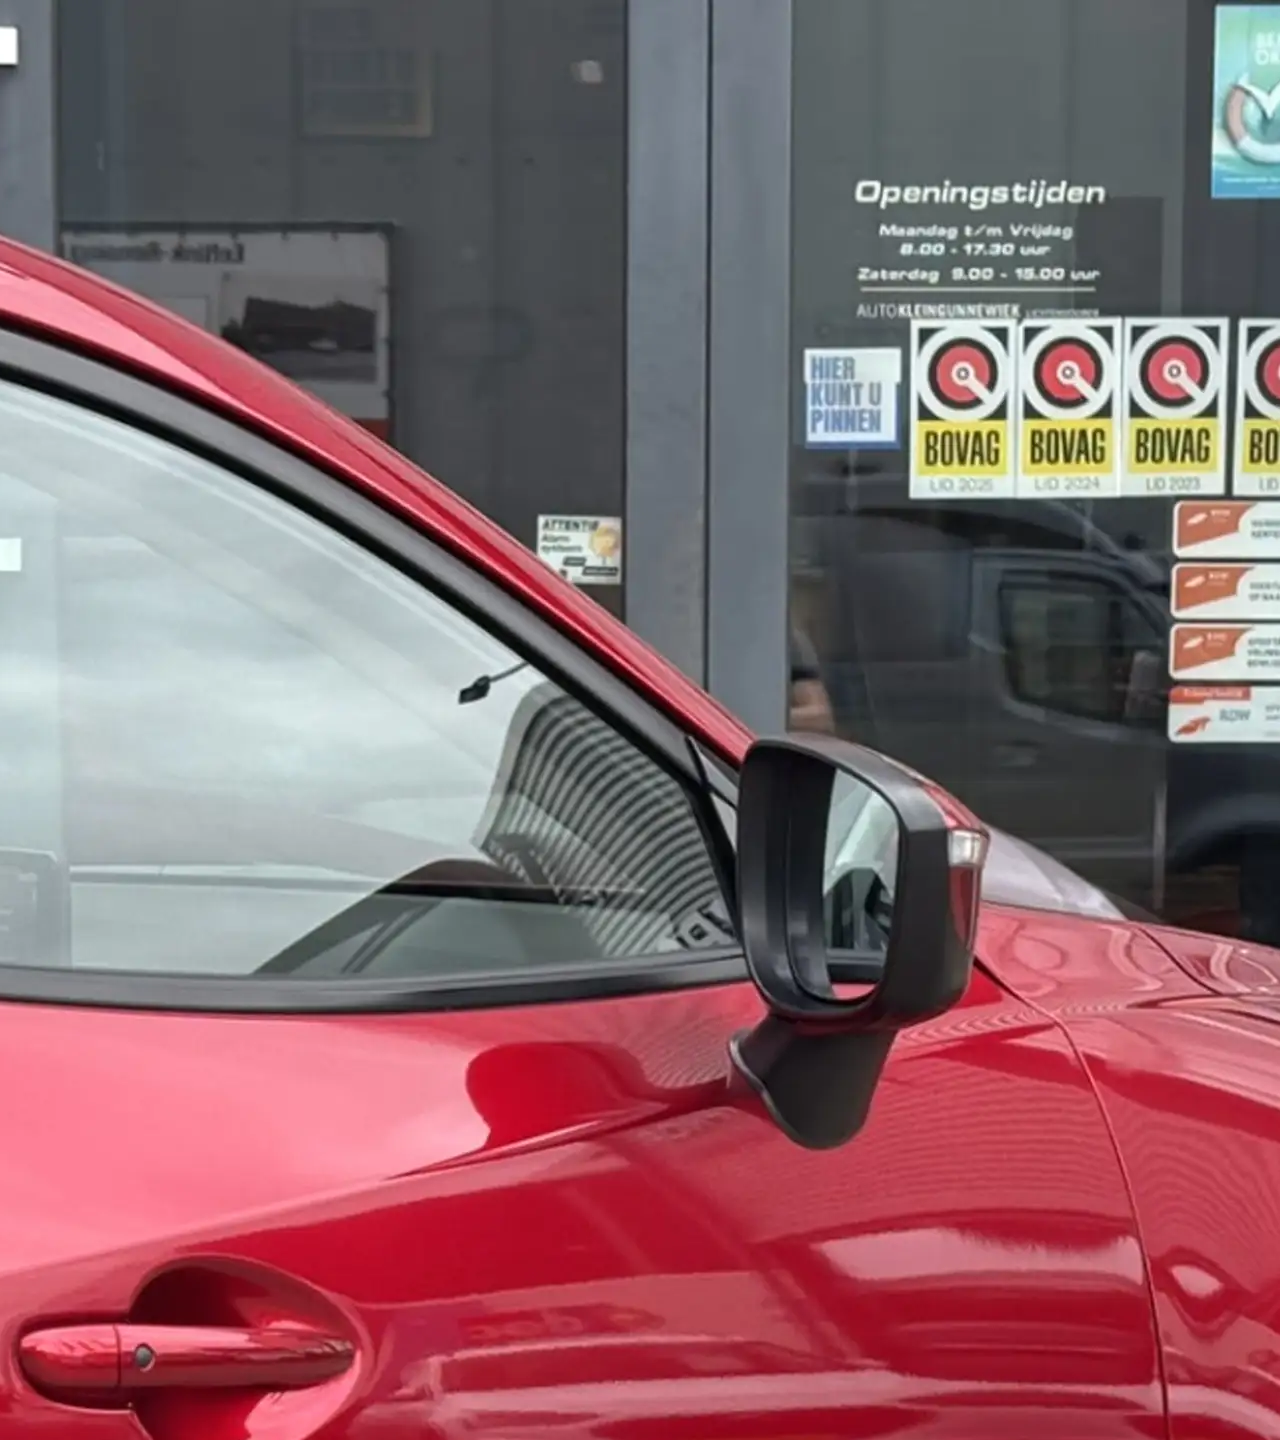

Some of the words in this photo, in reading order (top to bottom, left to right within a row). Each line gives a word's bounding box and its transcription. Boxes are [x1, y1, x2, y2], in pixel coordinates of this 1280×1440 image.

[855, 180, 1106, 210] Openingstijden
[879, 224, 959, 241] Maandag
[964, 224, 1003, 238] t/m
[1010, 224, 1074, 241] Vrijdag
[900, 243, 946, 256] 8.00
[963, 243, 1015, 256] 17.30
[1020, 246, 1051, 256] uur
[857, 267, 941, 284] Zaterdag
[951, 268, 995, 281] 9.00
[1014, 268, 1066, 281] 15.00
[1071, 270, 1101, 281] uur
[811, 356, 855, 380] HIER
[810, 382, 863, 406] KUNT
[869, 382, 882, 406] U
[810, 408, 882, 433] PINNEN
[924, 430, 1000, 467] BOVAG
[1030, 427, 1106, 465] BOVAG
[1134, 428, 1211, 464] BOVAG
[1146, 477, 1166, 491] LID
[1169, 477, 1201, 491] 2023
[1258, 478, 1279, 491] LID
